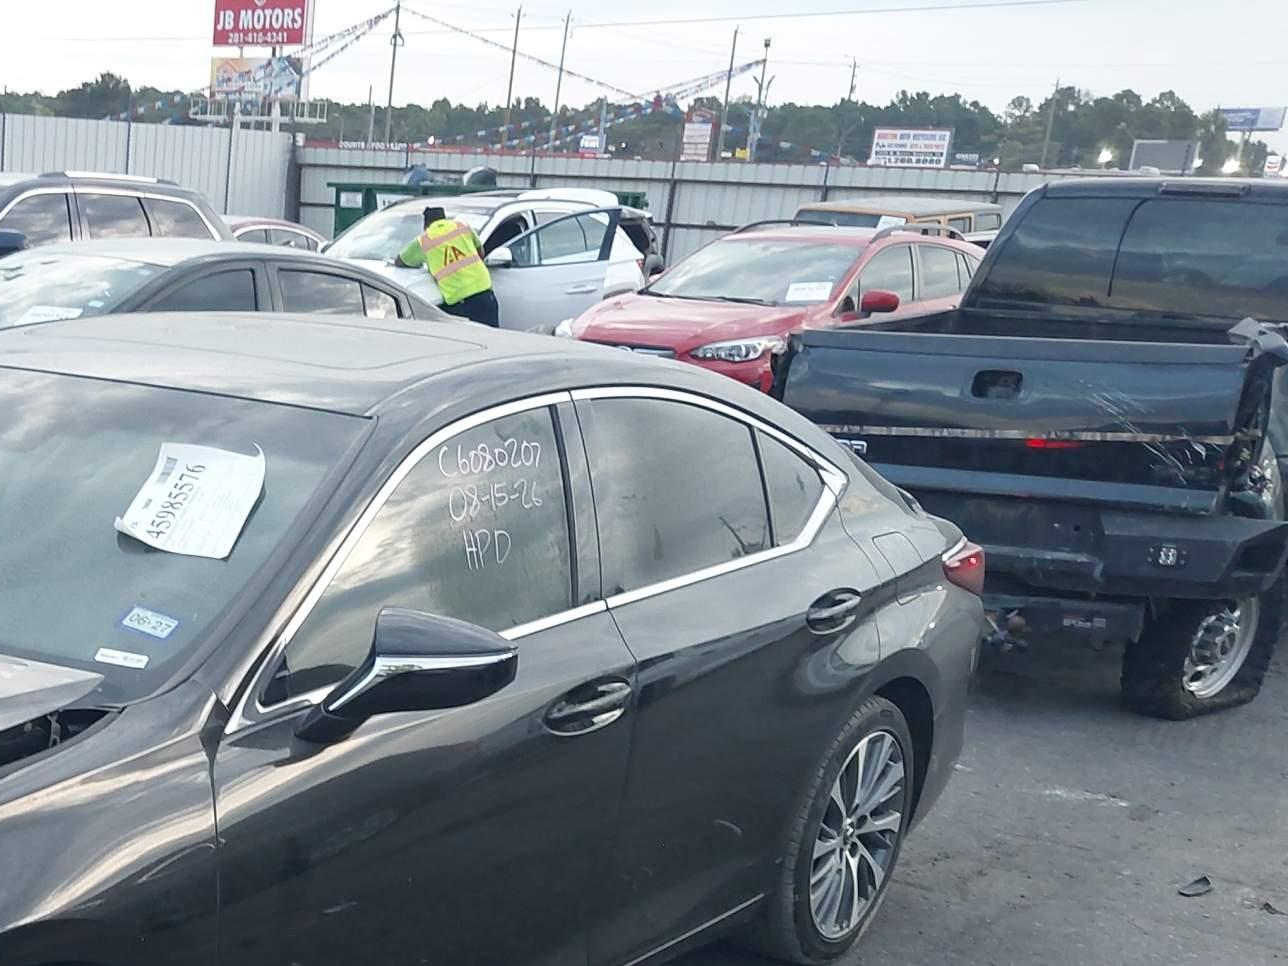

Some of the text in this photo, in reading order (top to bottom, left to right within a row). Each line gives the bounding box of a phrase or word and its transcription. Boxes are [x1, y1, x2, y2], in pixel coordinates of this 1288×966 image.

[217, 8, 302, 30] JB MOTORS
[146, 463, 207, 539] 45985576
[449, 479, 543, 521] 08-15-26
[463, 529, 512, 570] HPD
